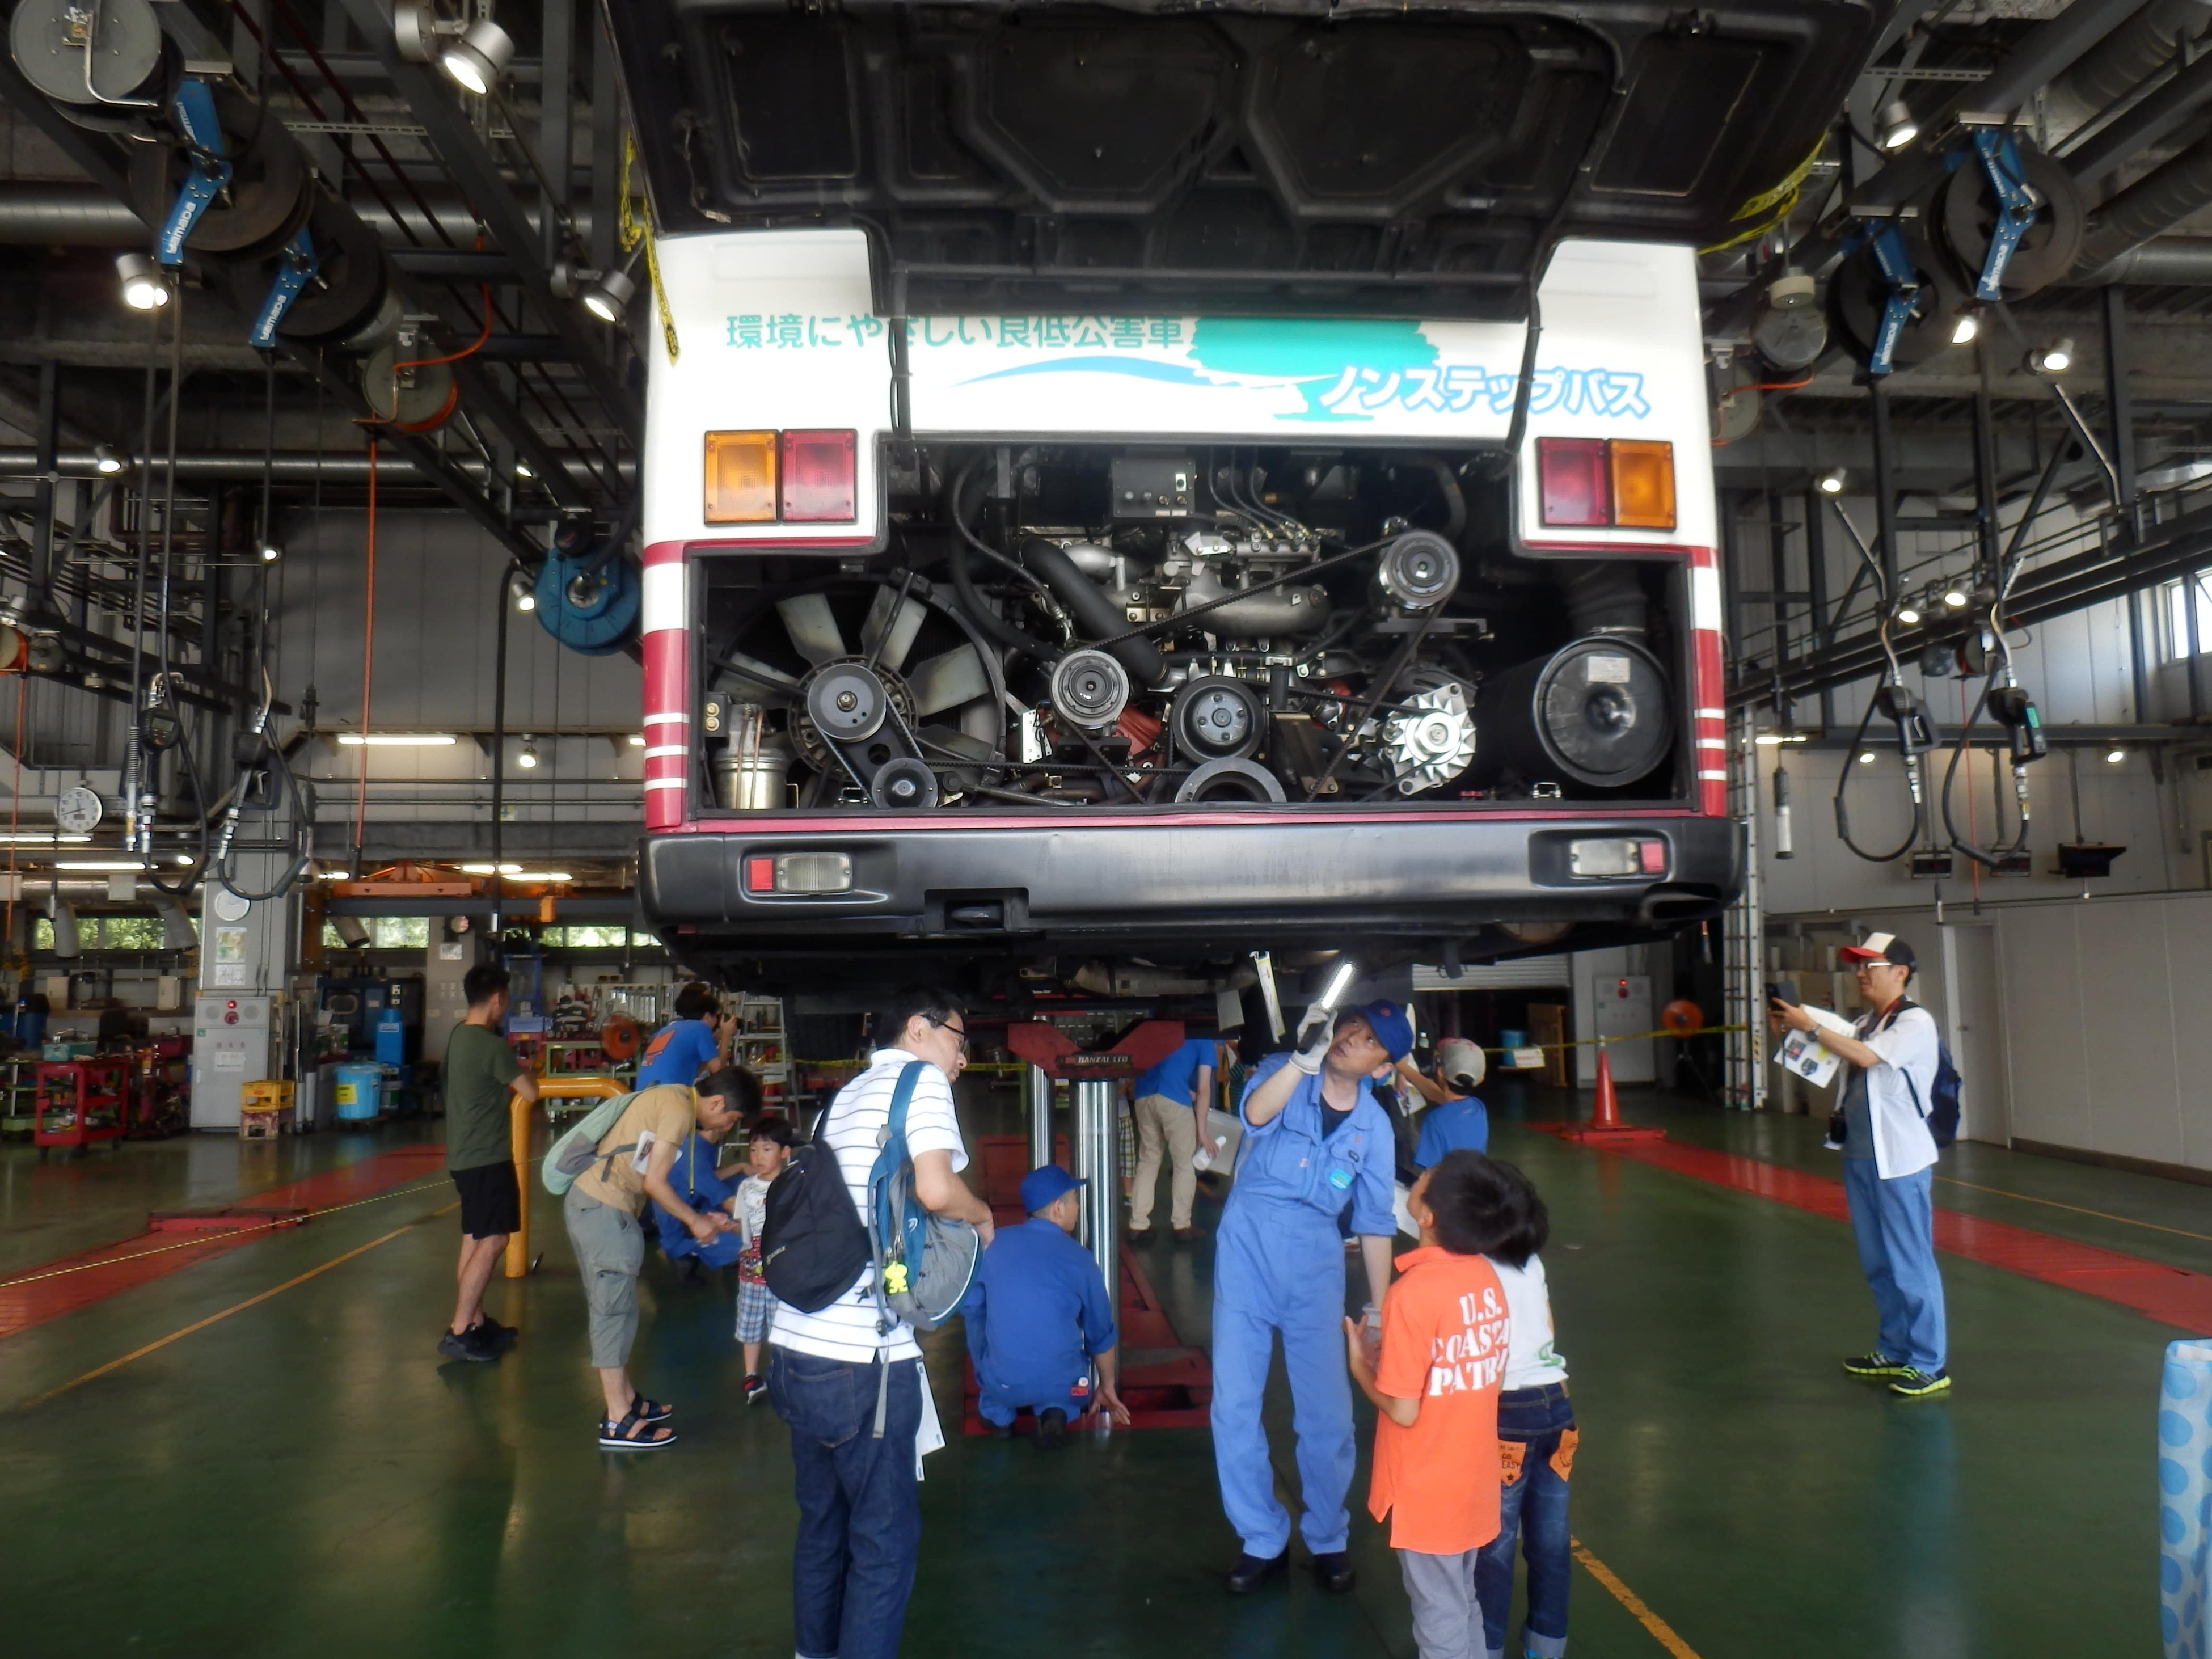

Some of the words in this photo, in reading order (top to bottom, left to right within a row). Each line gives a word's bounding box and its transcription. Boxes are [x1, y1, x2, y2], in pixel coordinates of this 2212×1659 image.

[1319, 366, 1651, 419] ノンステップバス
[1459, 1287, 1503, 1325] U.S.
